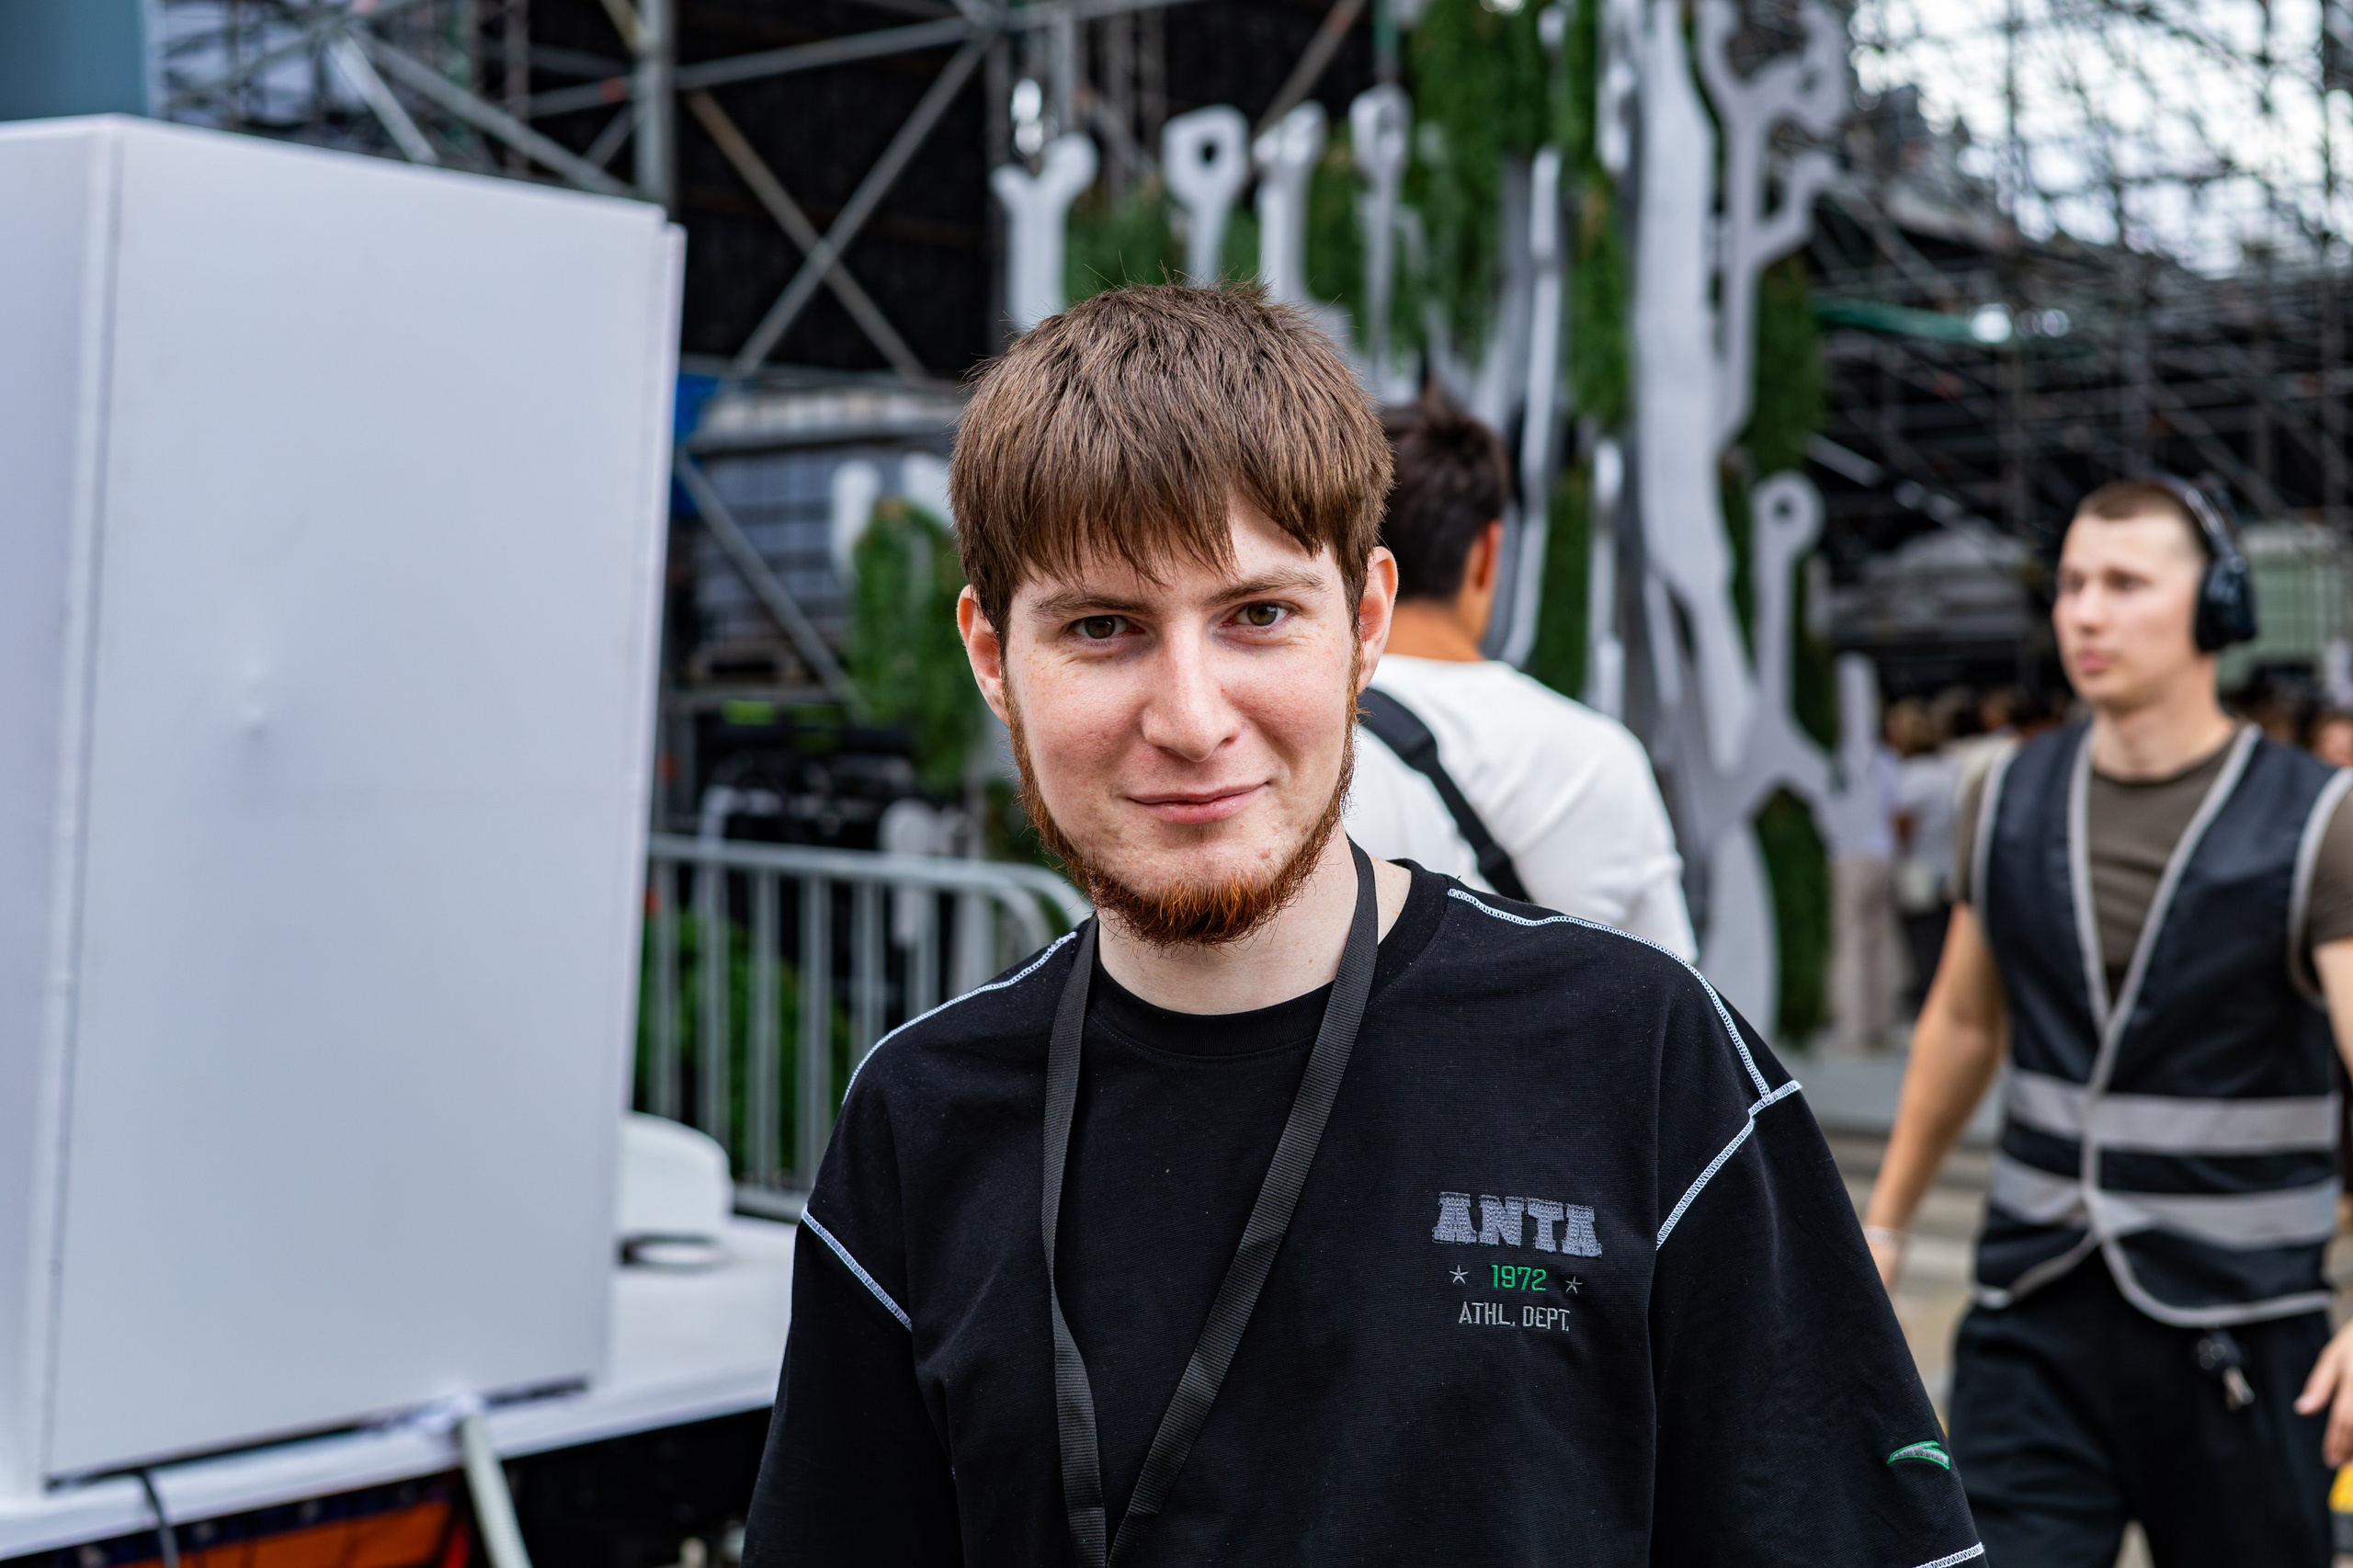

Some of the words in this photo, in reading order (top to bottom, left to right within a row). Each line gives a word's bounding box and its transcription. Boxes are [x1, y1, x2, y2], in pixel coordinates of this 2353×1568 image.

[1432, 1192, 1603, 1257] ANTA
[1491, 1264, 1547, 1291] 1972
[1458, 1301, 1516, 1327] ATHL.
[1522, 1305, 1571, 1332] DEPT.
